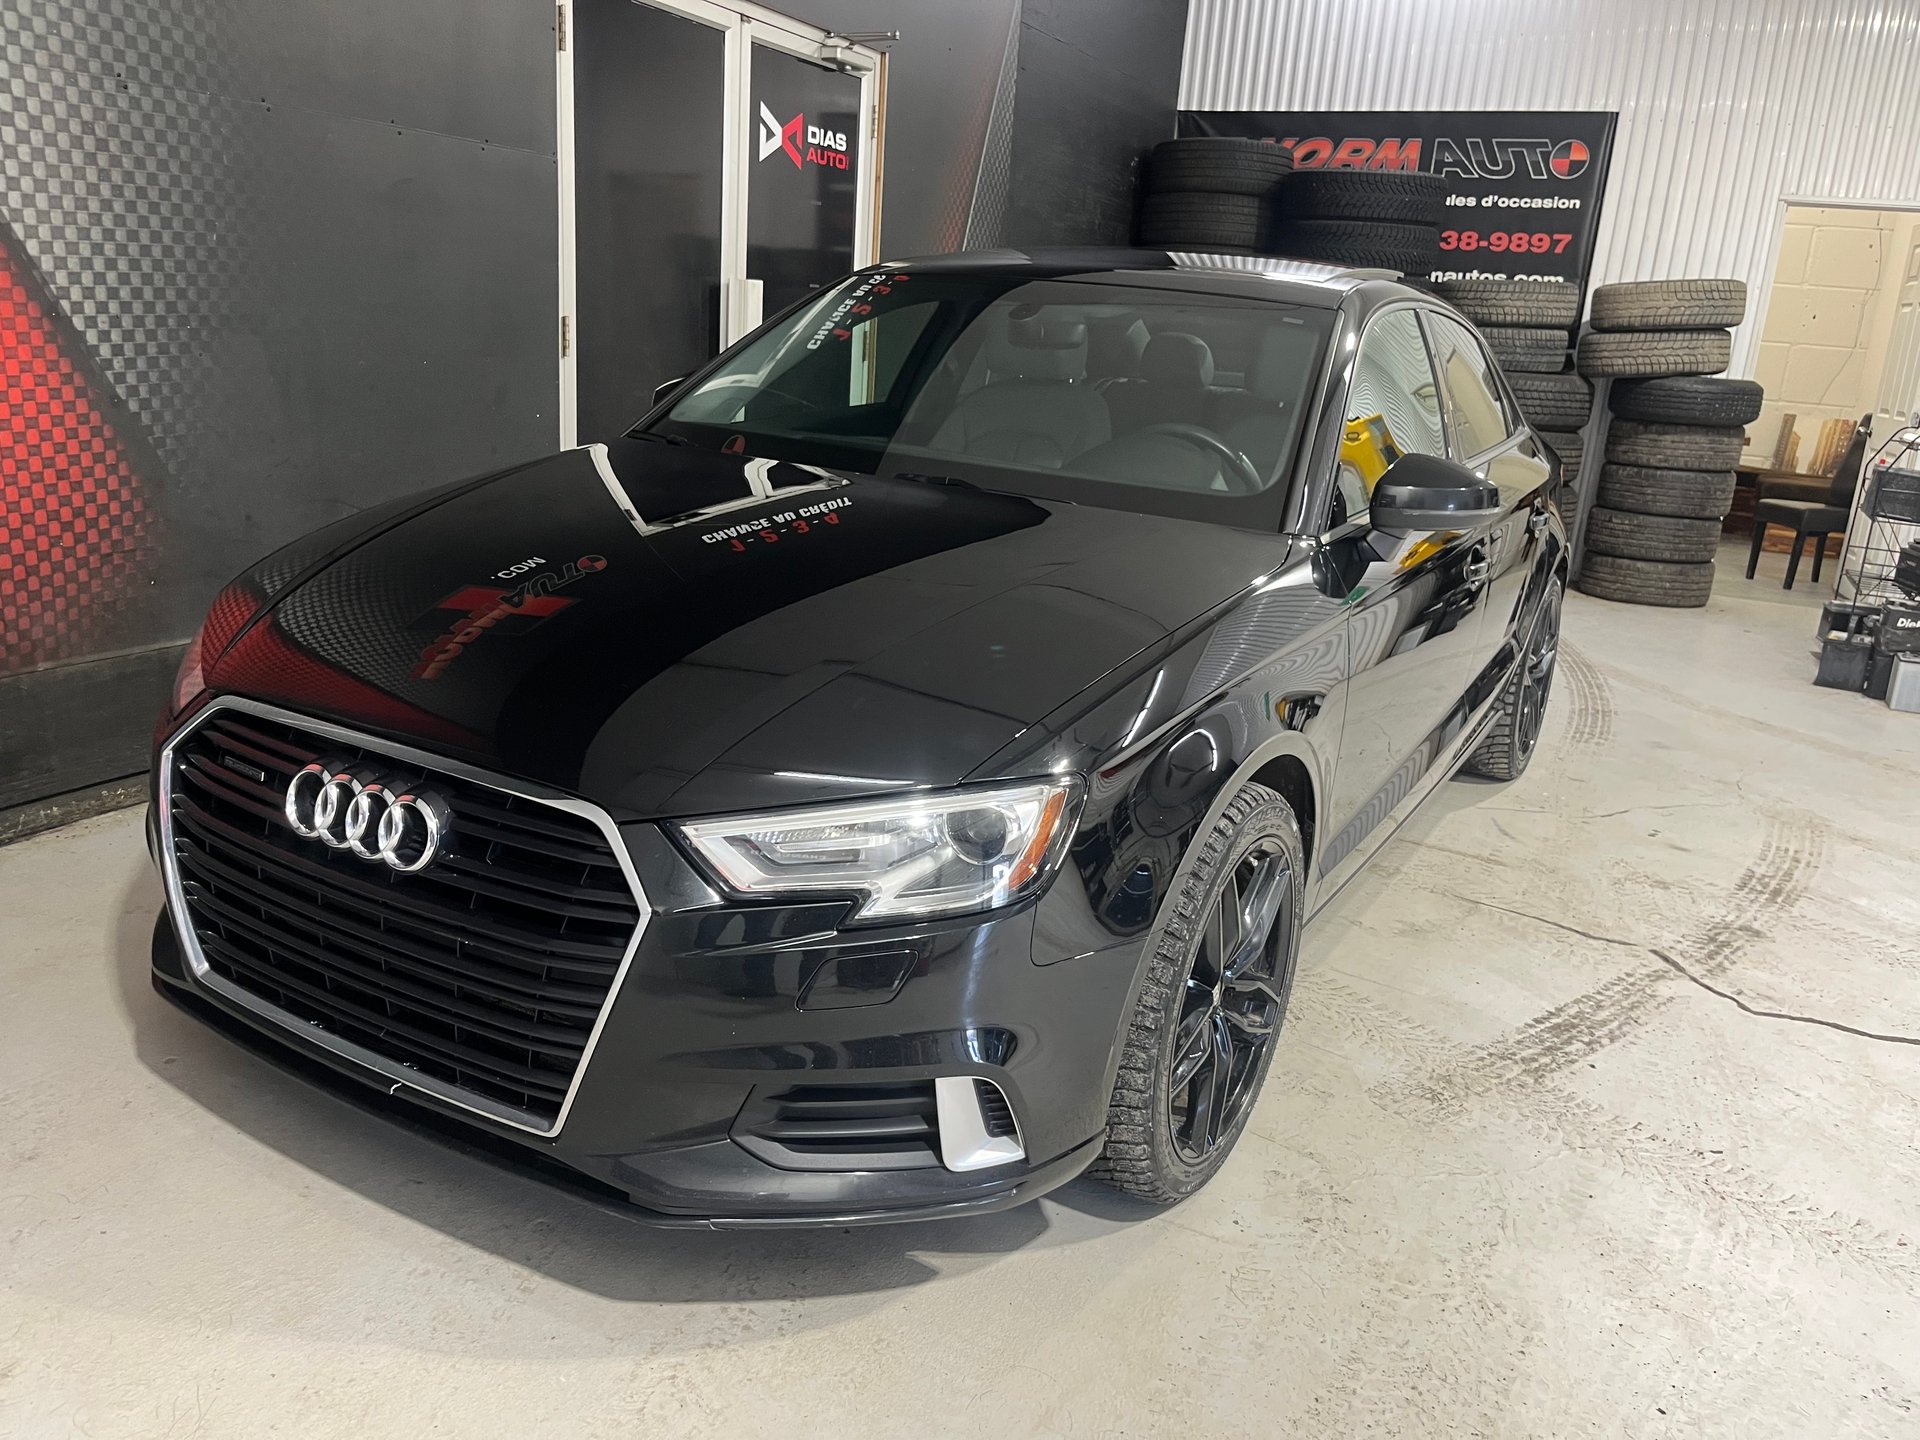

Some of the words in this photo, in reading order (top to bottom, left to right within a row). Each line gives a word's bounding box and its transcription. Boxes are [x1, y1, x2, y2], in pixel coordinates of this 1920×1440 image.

[807, 125, 847, 151] DIAS
[806, 147, 846, 169] AUTO
[1261, 137, 1423, 172] ORM
[1430, 137, 1590, 180] AUTO
[1481, 194, 1581, 209] d'occasion
[1439, 230, 1573, 254] 38-9897
